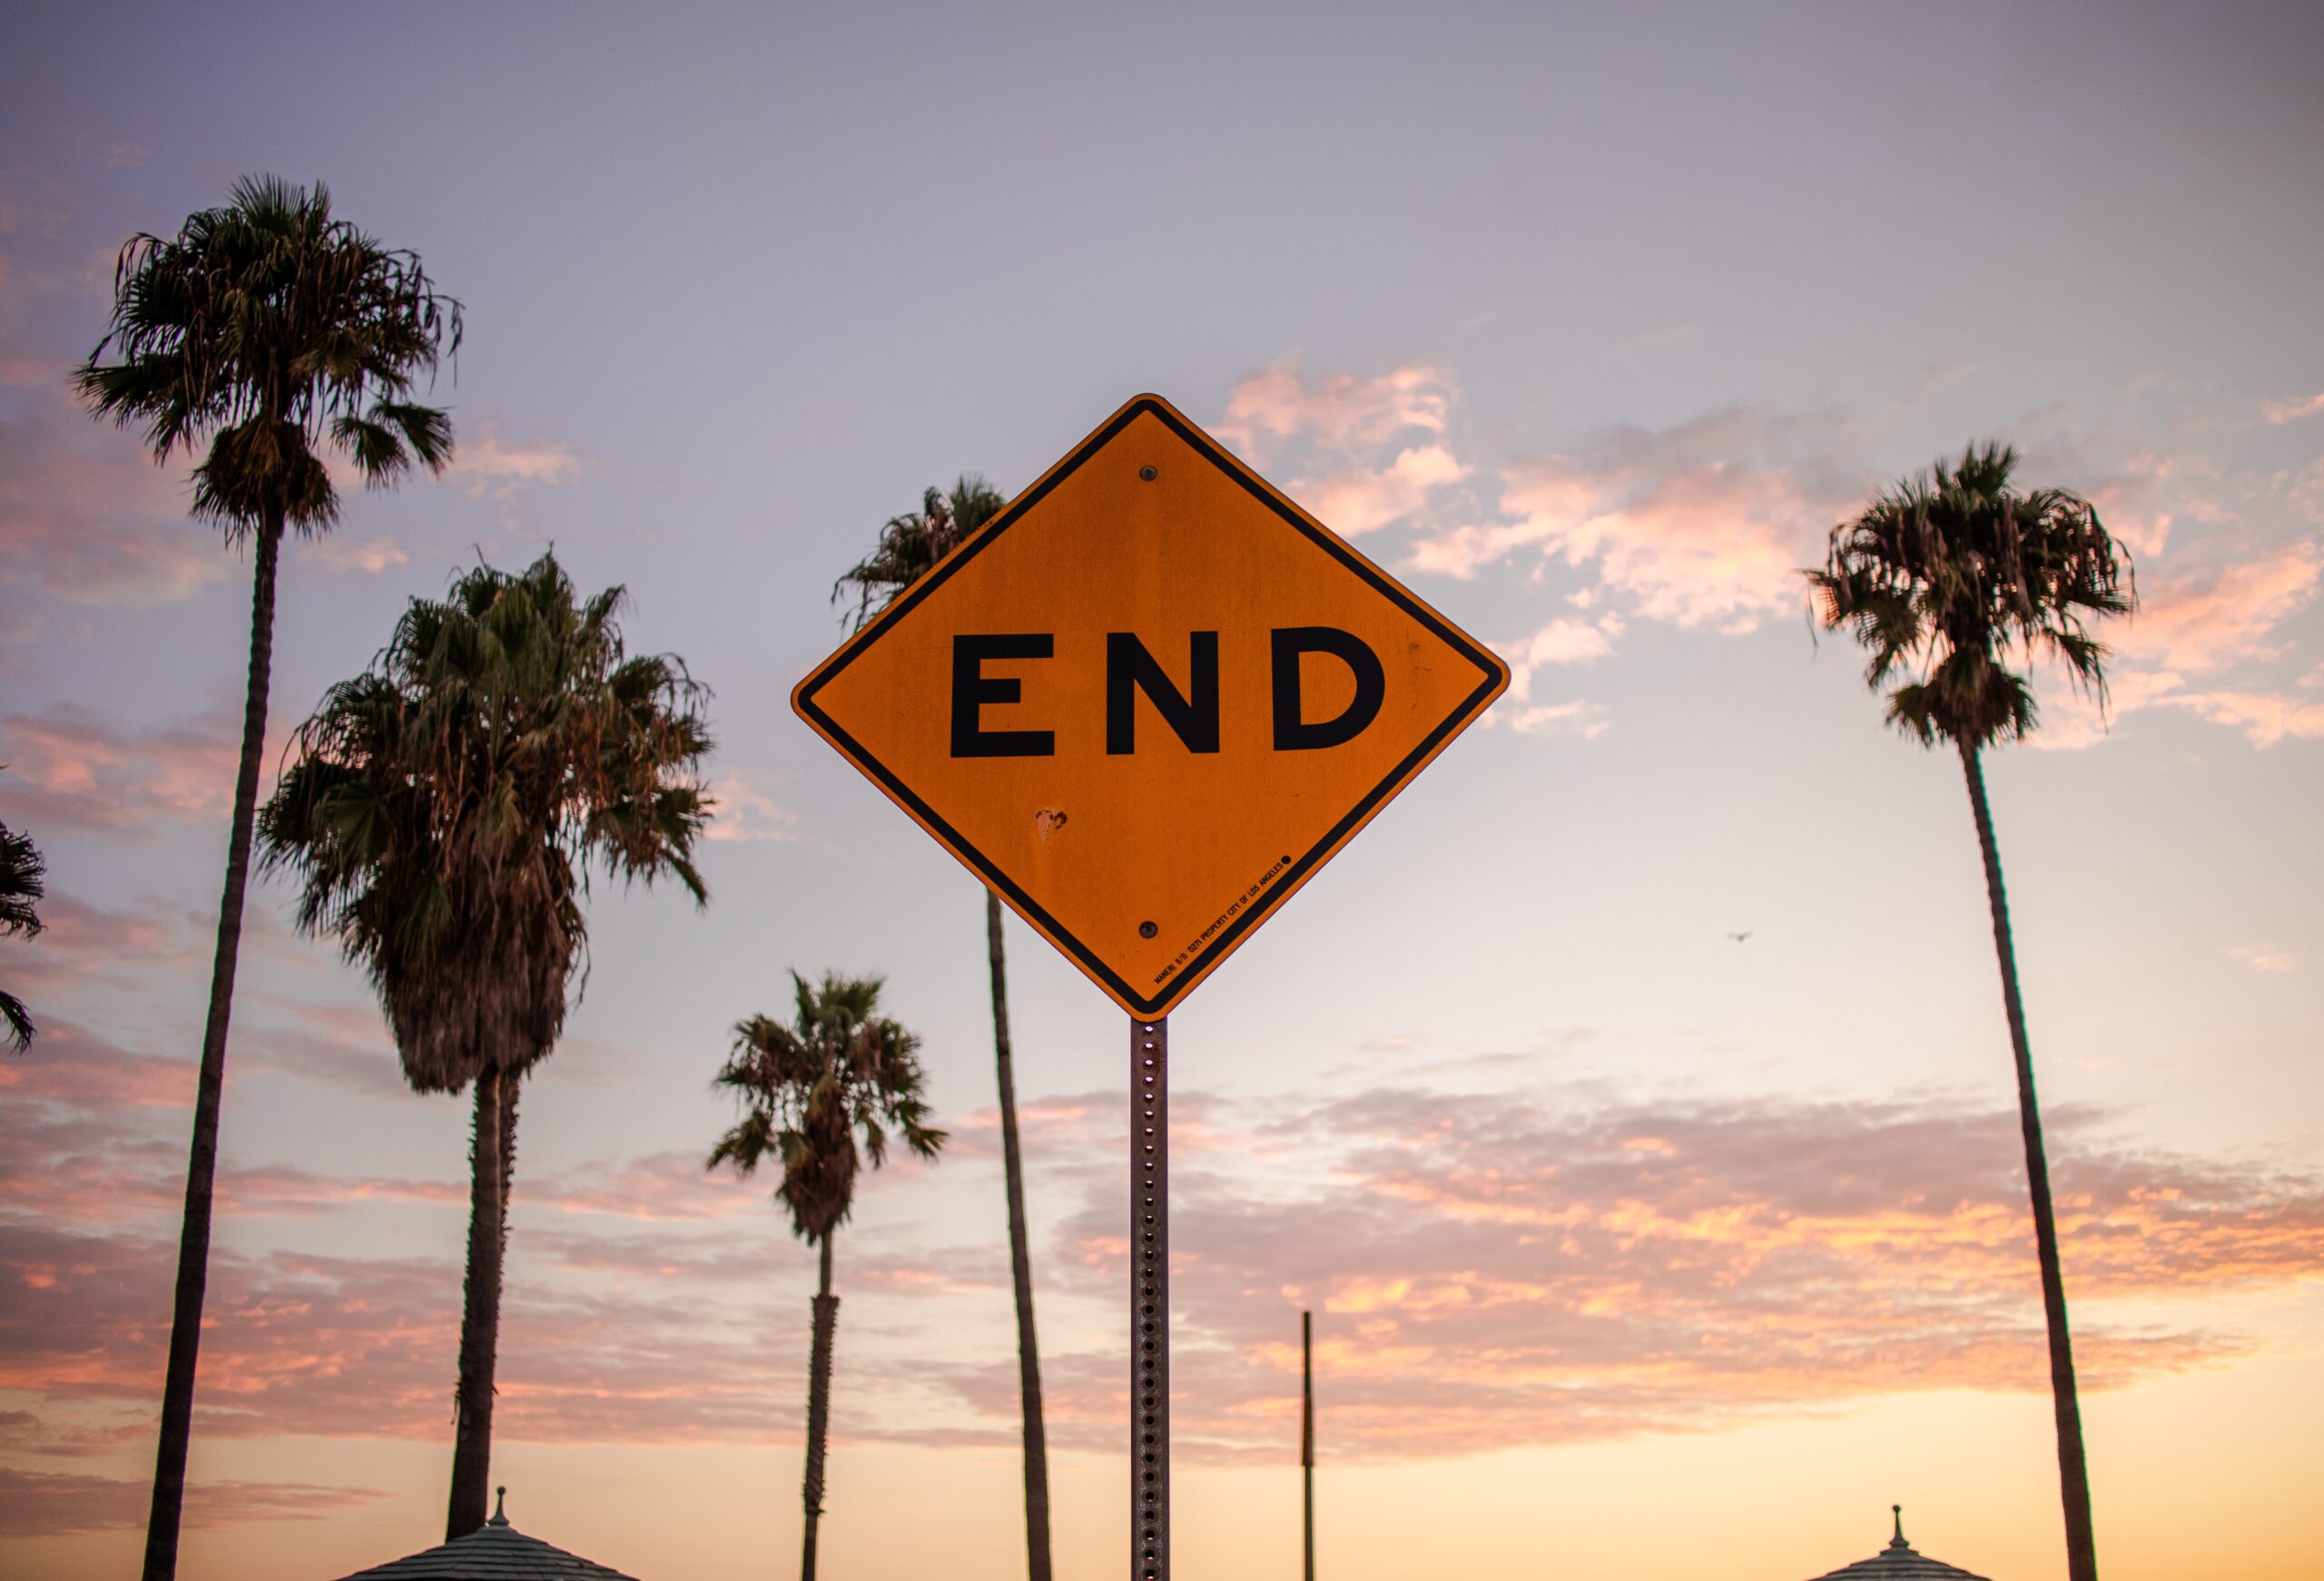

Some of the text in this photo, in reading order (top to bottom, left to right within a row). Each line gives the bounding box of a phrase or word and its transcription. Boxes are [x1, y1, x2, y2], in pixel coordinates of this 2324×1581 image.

[950, 626, 1385, 758] END
[1154, 964, 1177, 984] MANERI
[1200, 914, 1228, 940] PROPERTY
[1226, 902, 1241, 915] CITY
[1239, 894, 1248, 904] OF
[1247, 884, 1260, 897] LOS
[1259, 862, 1284, 886] ANGELES
